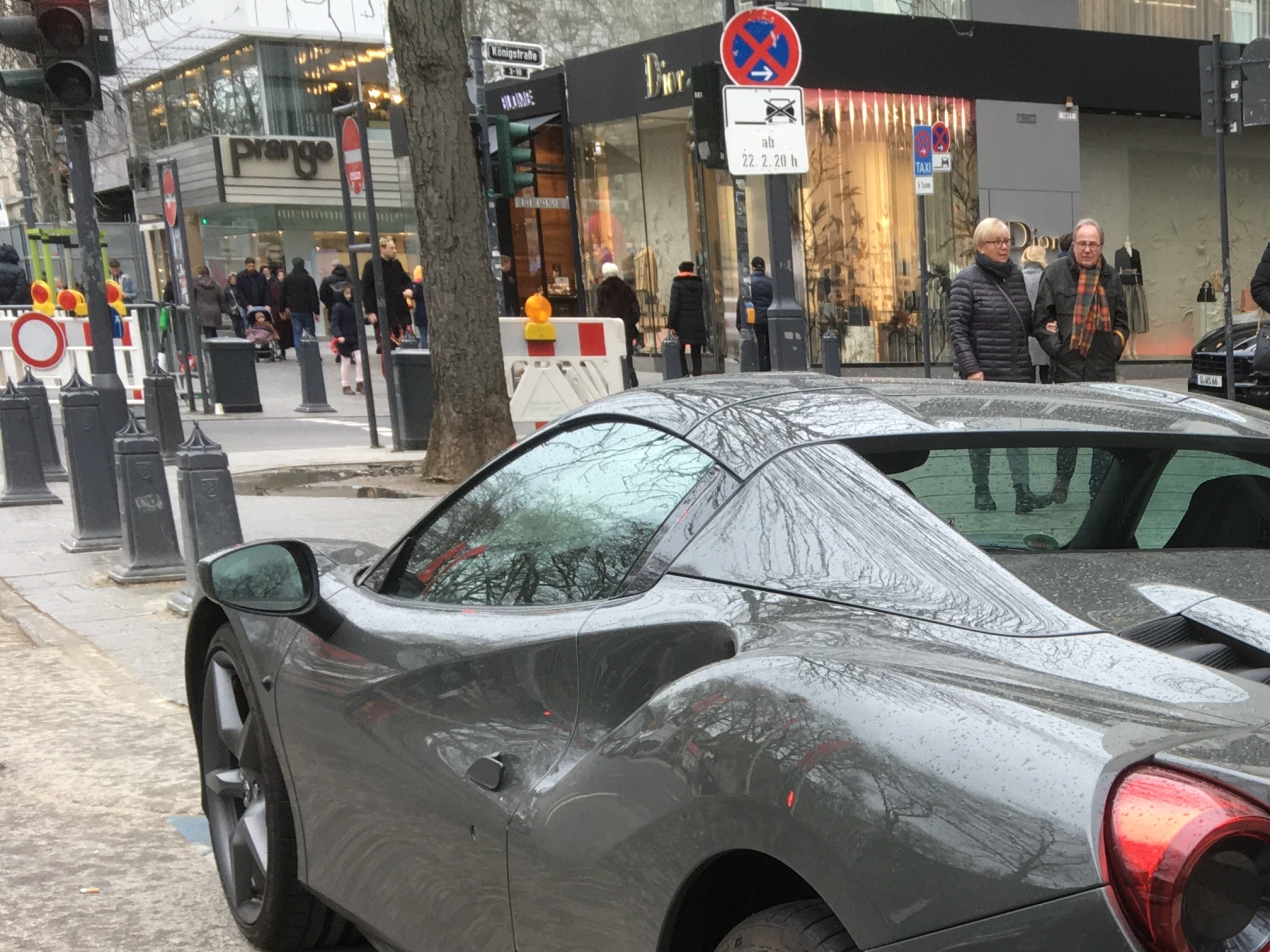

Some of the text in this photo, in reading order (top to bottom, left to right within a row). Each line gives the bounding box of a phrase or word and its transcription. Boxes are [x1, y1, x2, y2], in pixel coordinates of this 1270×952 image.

[491, 45, 538, 61] Königstraße
[642, 52, 686, 99] Dior
[761, 135, 774, 148] ab
[229, 137, 333, 180] prange
[790, 153, 798, 168] h
[916, 161, 932, 174] TAXI
[1006, 221, 1060, 250] Dior
